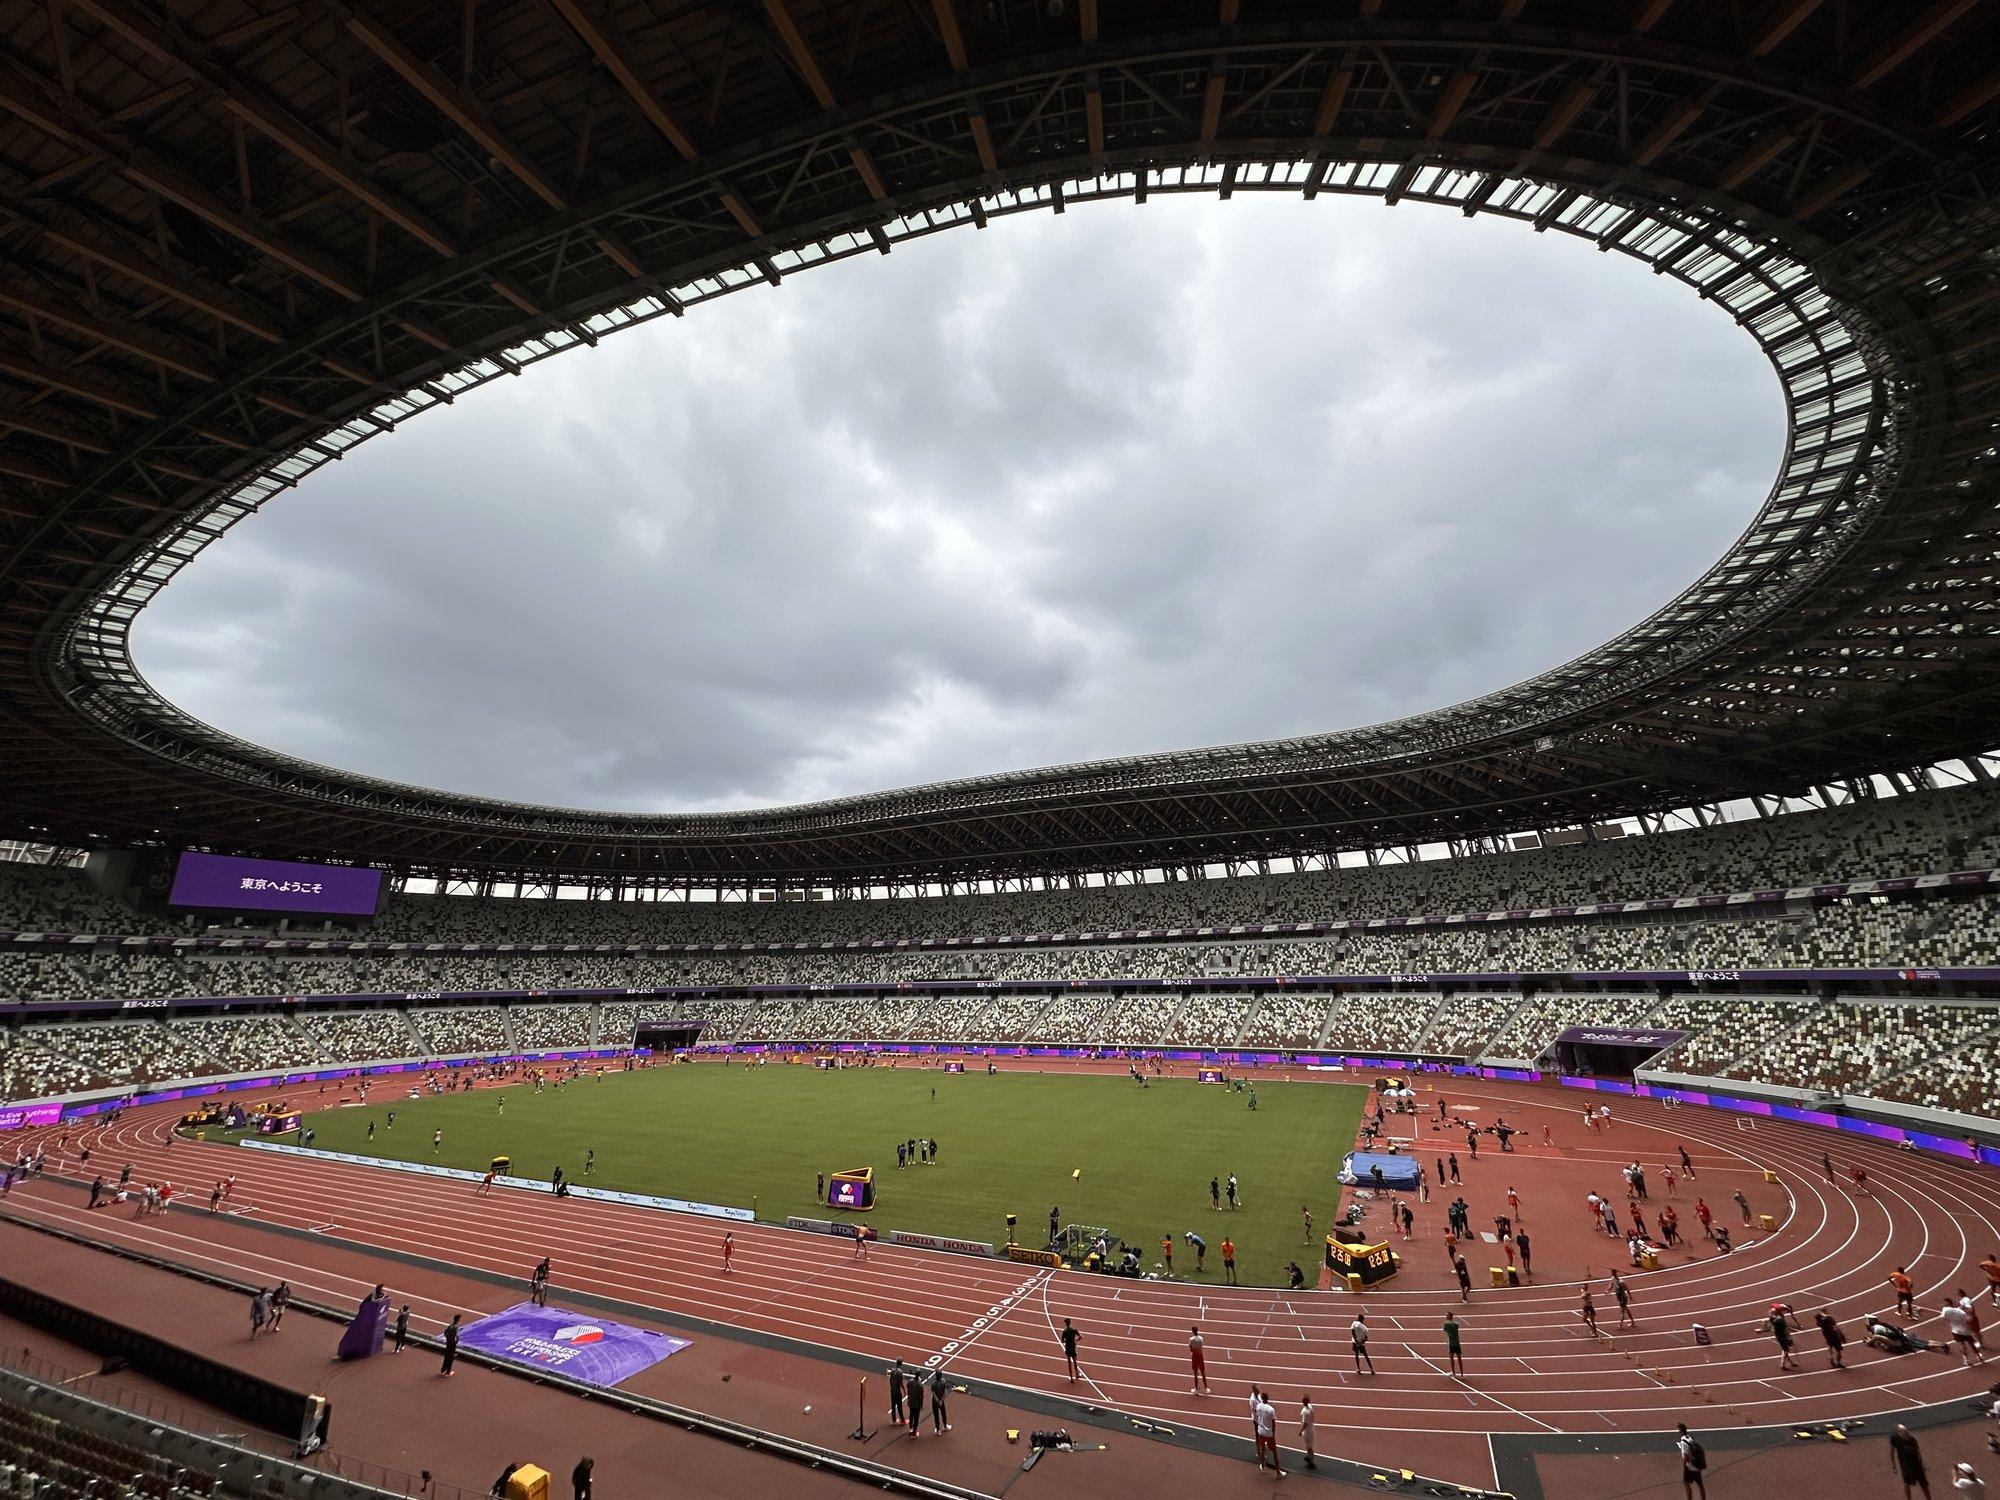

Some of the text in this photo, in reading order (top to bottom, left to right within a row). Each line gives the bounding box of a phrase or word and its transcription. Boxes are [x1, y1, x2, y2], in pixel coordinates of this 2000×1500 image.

[240, 877, 323, 894] 東京へようこそ
[1390, 975, 1428, 983] 東京へようこそ
[1687, 972, 1740, 981] 東京へようこそ
[122, 1000, 168, 1009] 東京へようこそ
[838, 1225, 854, 1236] TDK
[896, 1234, 985, 1254] HONDA HONDA
[1011, 1249, 1054, 1265] SEIKO
[1035, 1269, 1046, 1277] 1
[1022, 1278, 1038, 1286] 2
[1012, 1287, 1026, 1296] 3
[1000, 1297, 1013, 1306] 4
[986, 1306, 1002, 1316] 5
[972, 1317, 989, 1328] 6
[958, 1329, 976, 1340] 7
[941, 1341, 959, 1353] 8
[924, 1355, 943, 1367] 9
